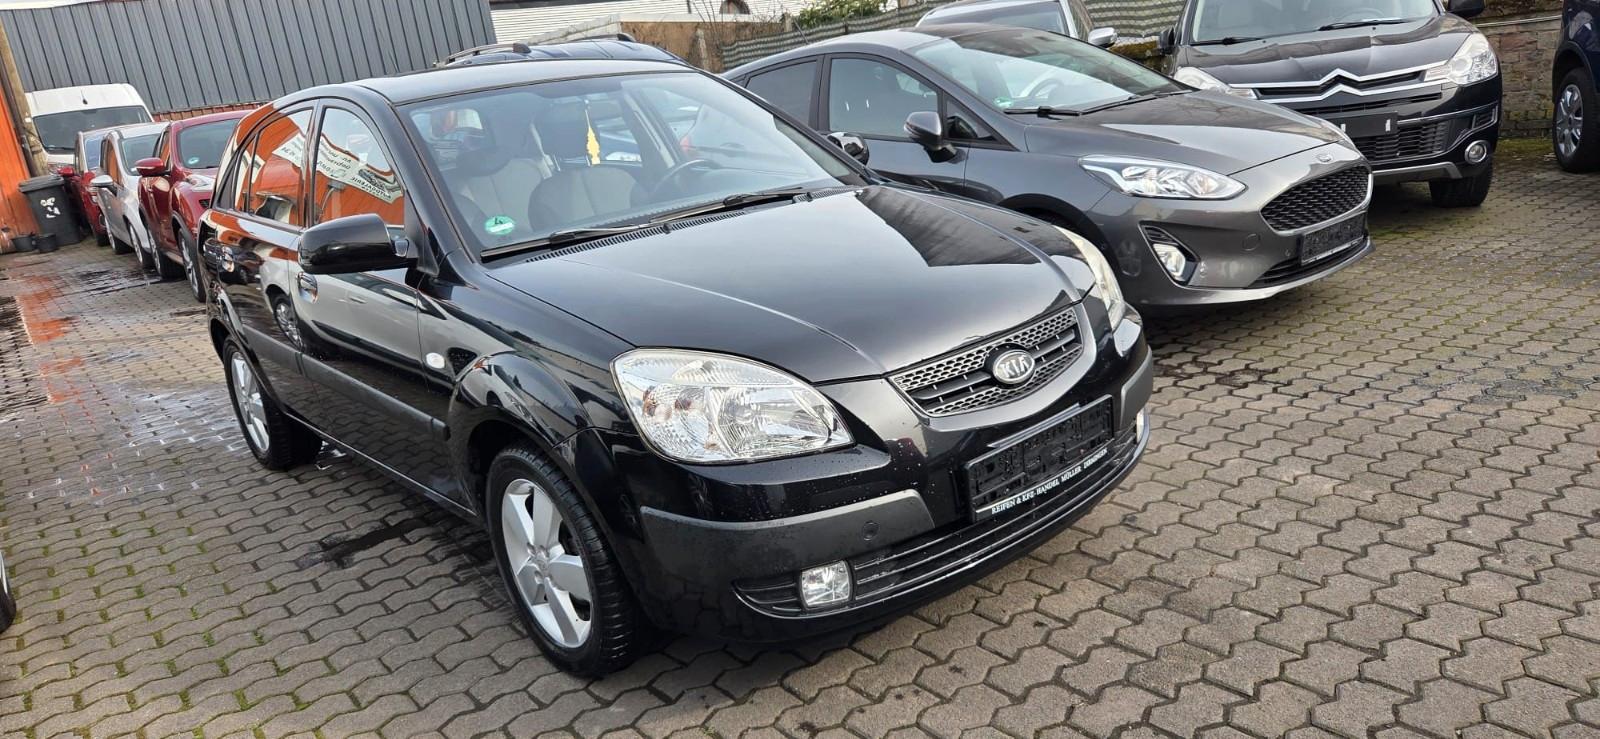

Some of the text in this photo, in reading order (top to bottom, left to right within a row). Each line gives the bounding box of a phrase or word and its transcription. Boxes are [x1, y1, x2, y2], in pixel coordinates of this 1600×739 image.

[999, 354, 1030, 378] KIA
[991, 499, 1016, 514] REIFEN
[1016, 497, 1022, 505] &
[1061, 466, 1082, 482] MÜLLER
